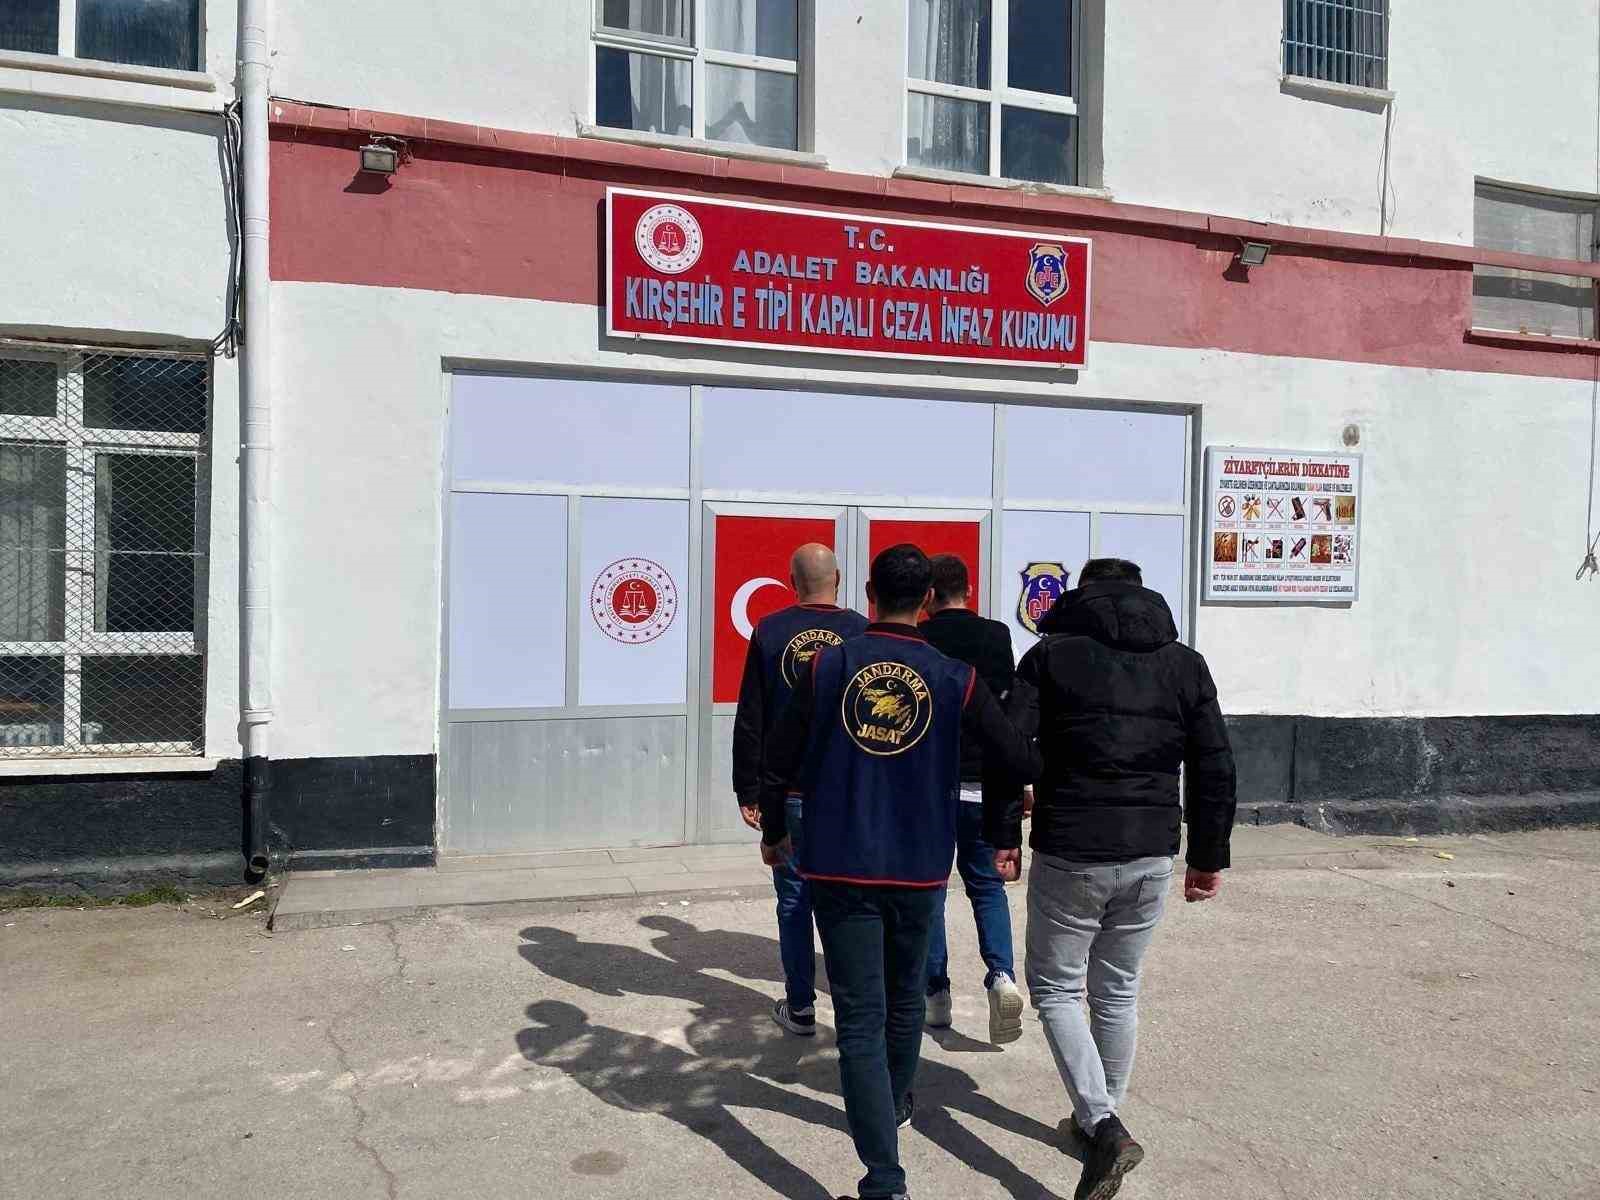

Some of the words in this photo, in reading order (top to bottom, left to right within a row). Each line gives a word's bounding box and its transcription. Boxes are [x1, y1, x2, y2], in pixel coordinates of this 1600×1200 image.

[843, 225, 894, 252] T.C.
[733, 249, 838, 281] ADALET
[855, 263, 990, 295] BAKANLIĞI
[625, 275, 724, 329] KIRŞEHİR
[733, 287, 746, 329] E
[754, 282, 793, 332] TİPİ
[801, 292, 874, 339] KAPALI
[881, 300, 933, 343] CEZA
[940, 293, 994, 347] İNFAZ
[1001, 309, 1077, 353] KURUMU
[1224, 456, 1300, 479] ZİYARETÇİLERİN
[1302, 458, 1350, 479] DİKKATİNE
[791, 631, 842, 652] JANDARM
[857, 664, 928, 702] JANDARMA
[857, 723, 906, 745] JASAT
